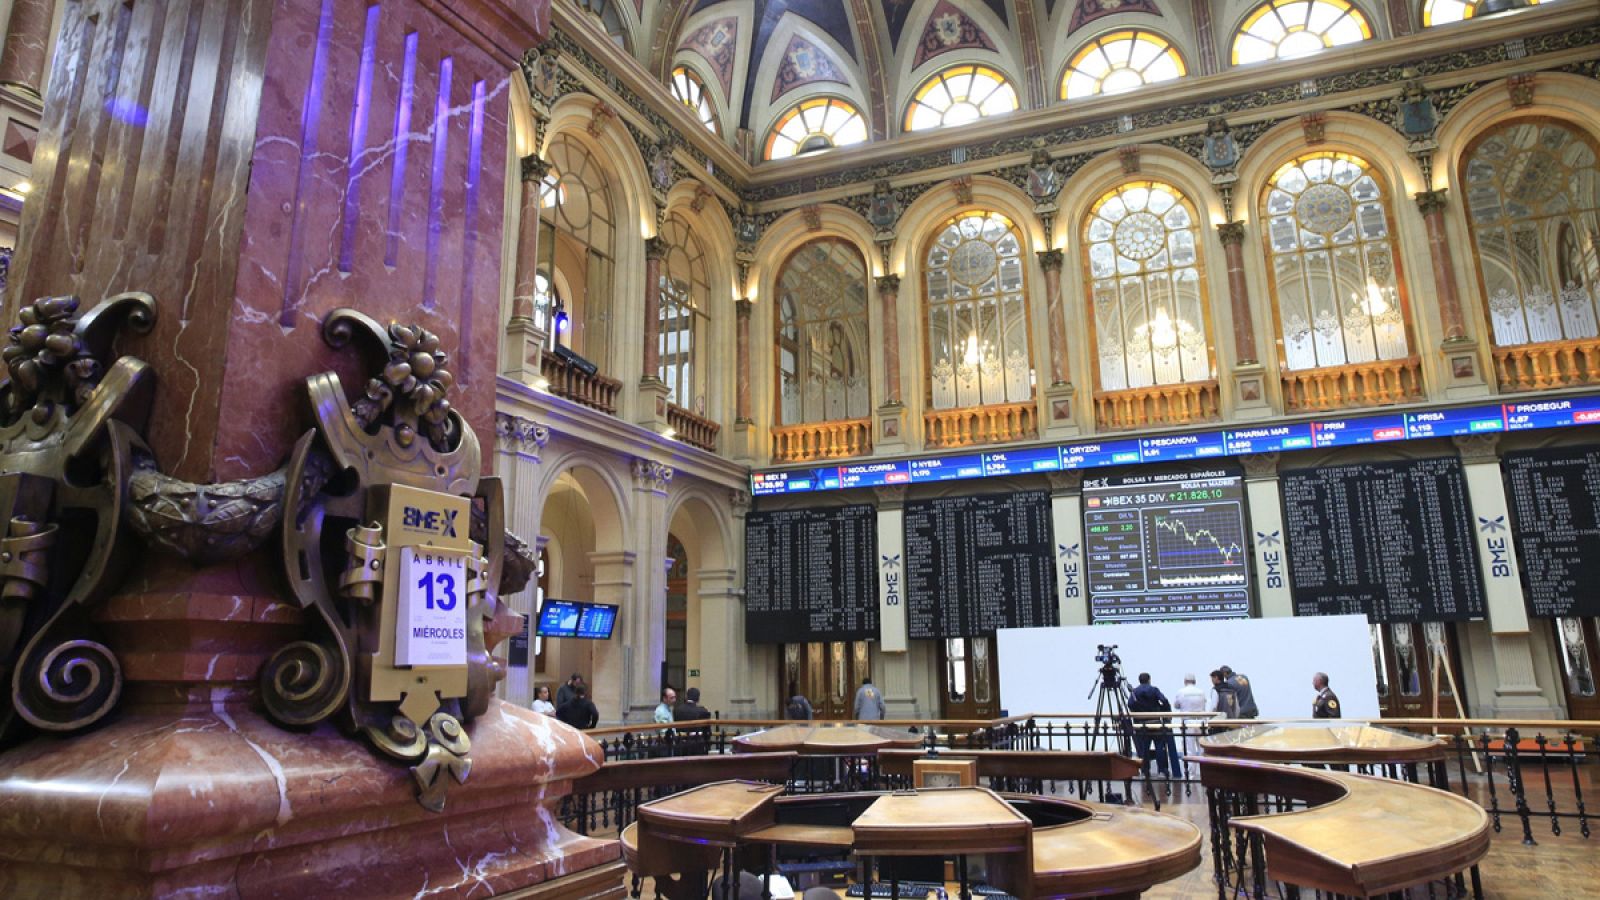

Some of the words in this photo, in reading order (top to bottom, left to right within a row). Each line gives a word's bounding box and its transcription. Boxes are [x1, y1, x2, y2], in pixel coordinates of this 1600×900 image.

[1517, 401, 1571, 412] PROSEGUR
[1418, 413, 1444, 422] PRISA
[1236, 429, 1269, 439] PHARMA
[1271, 428, 1288, 436] MAR
[1150, 436, 1198, 446] PESCANOVA
[1069, 445, 1100, 454] ORYZON
[1154, 473, 1188, 481] MERCADOS
[1190, 470, 1226, 479] ESPAÑOLES
[1110, 496, 1132, 505] IBEX
[1135, 494, 1146, 504] 35
[412, 554, 462, 569] ABRIL
[418, 572, 457, 611] 13
[412, 625, 464, 640] MIÉRCOLES
